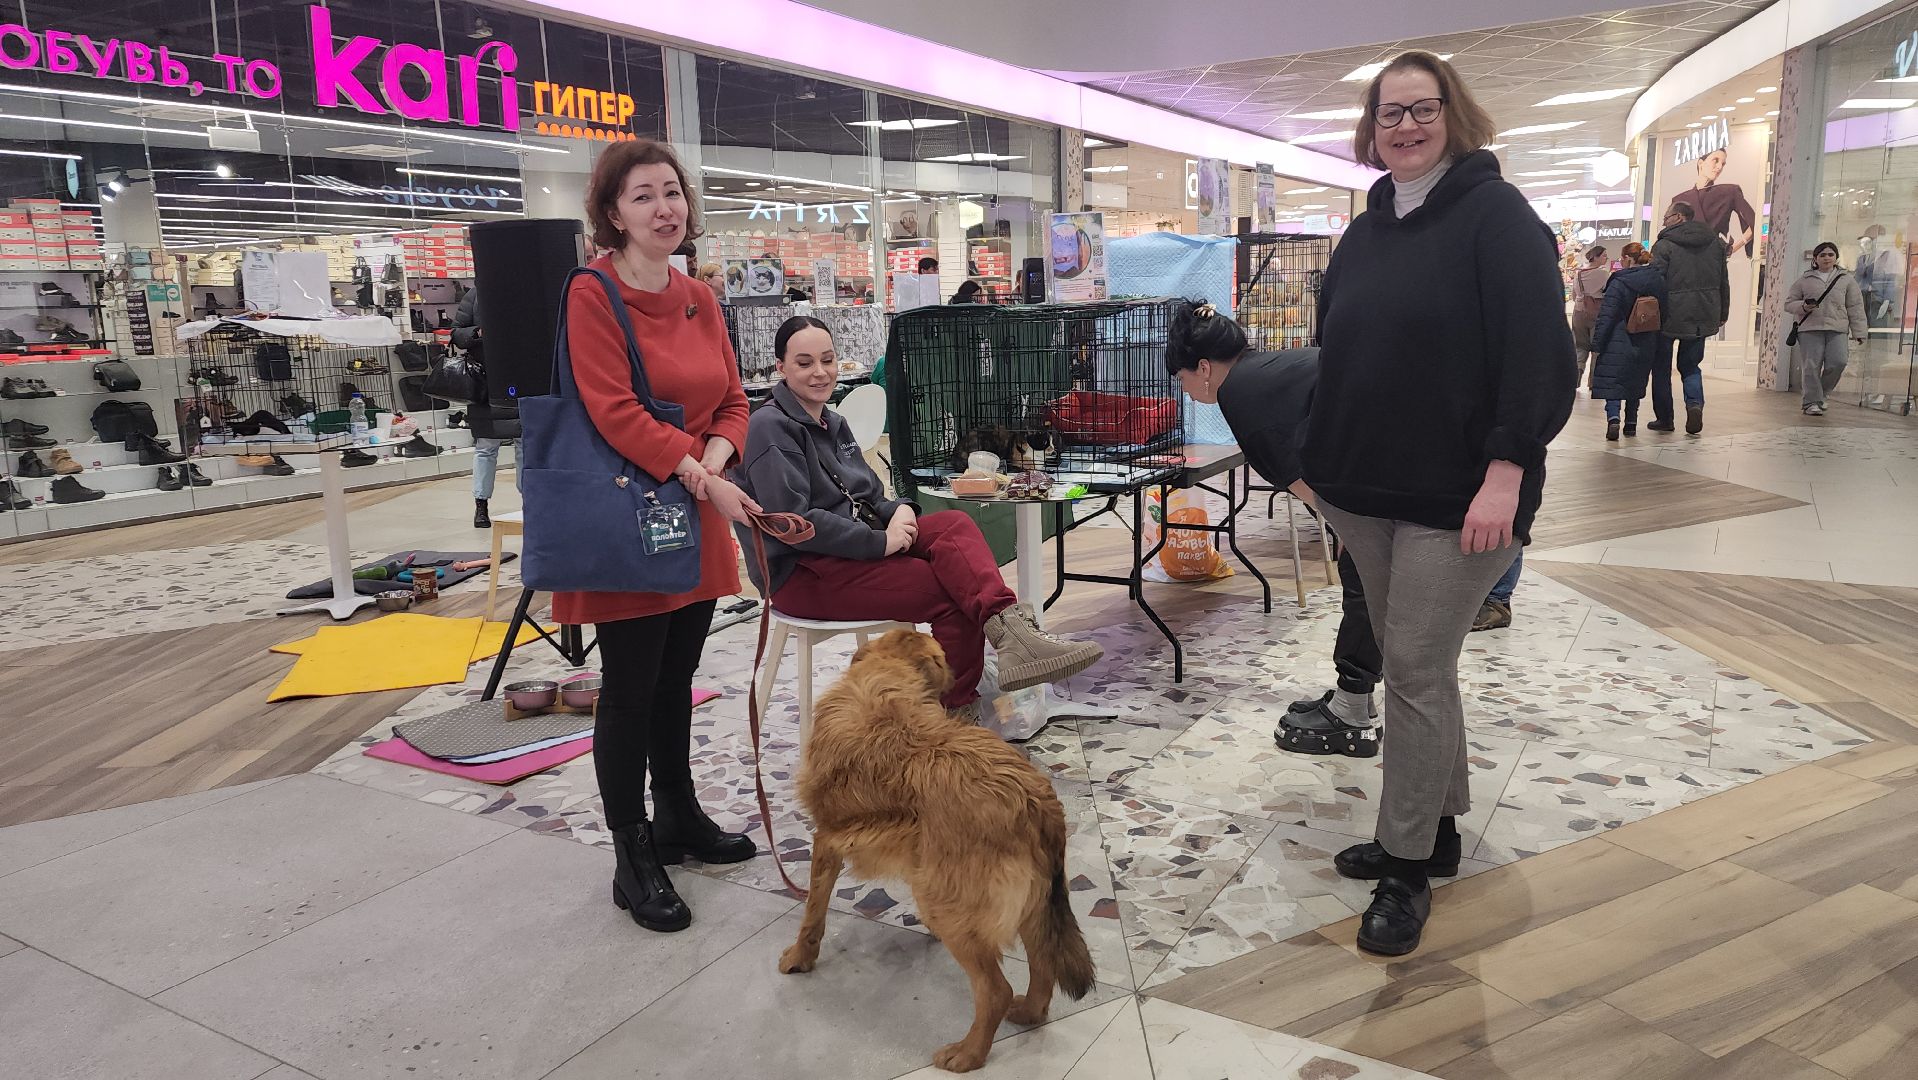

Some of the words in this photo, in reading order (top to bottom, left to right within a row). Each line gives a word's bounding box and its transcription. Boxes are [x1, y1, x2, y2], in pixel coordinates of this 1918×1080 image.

[309, 4, 519, 132] kari
[534, 80, 635, 125] ГИПЕР
[1674, 118, 1729, 167] ZARINA
